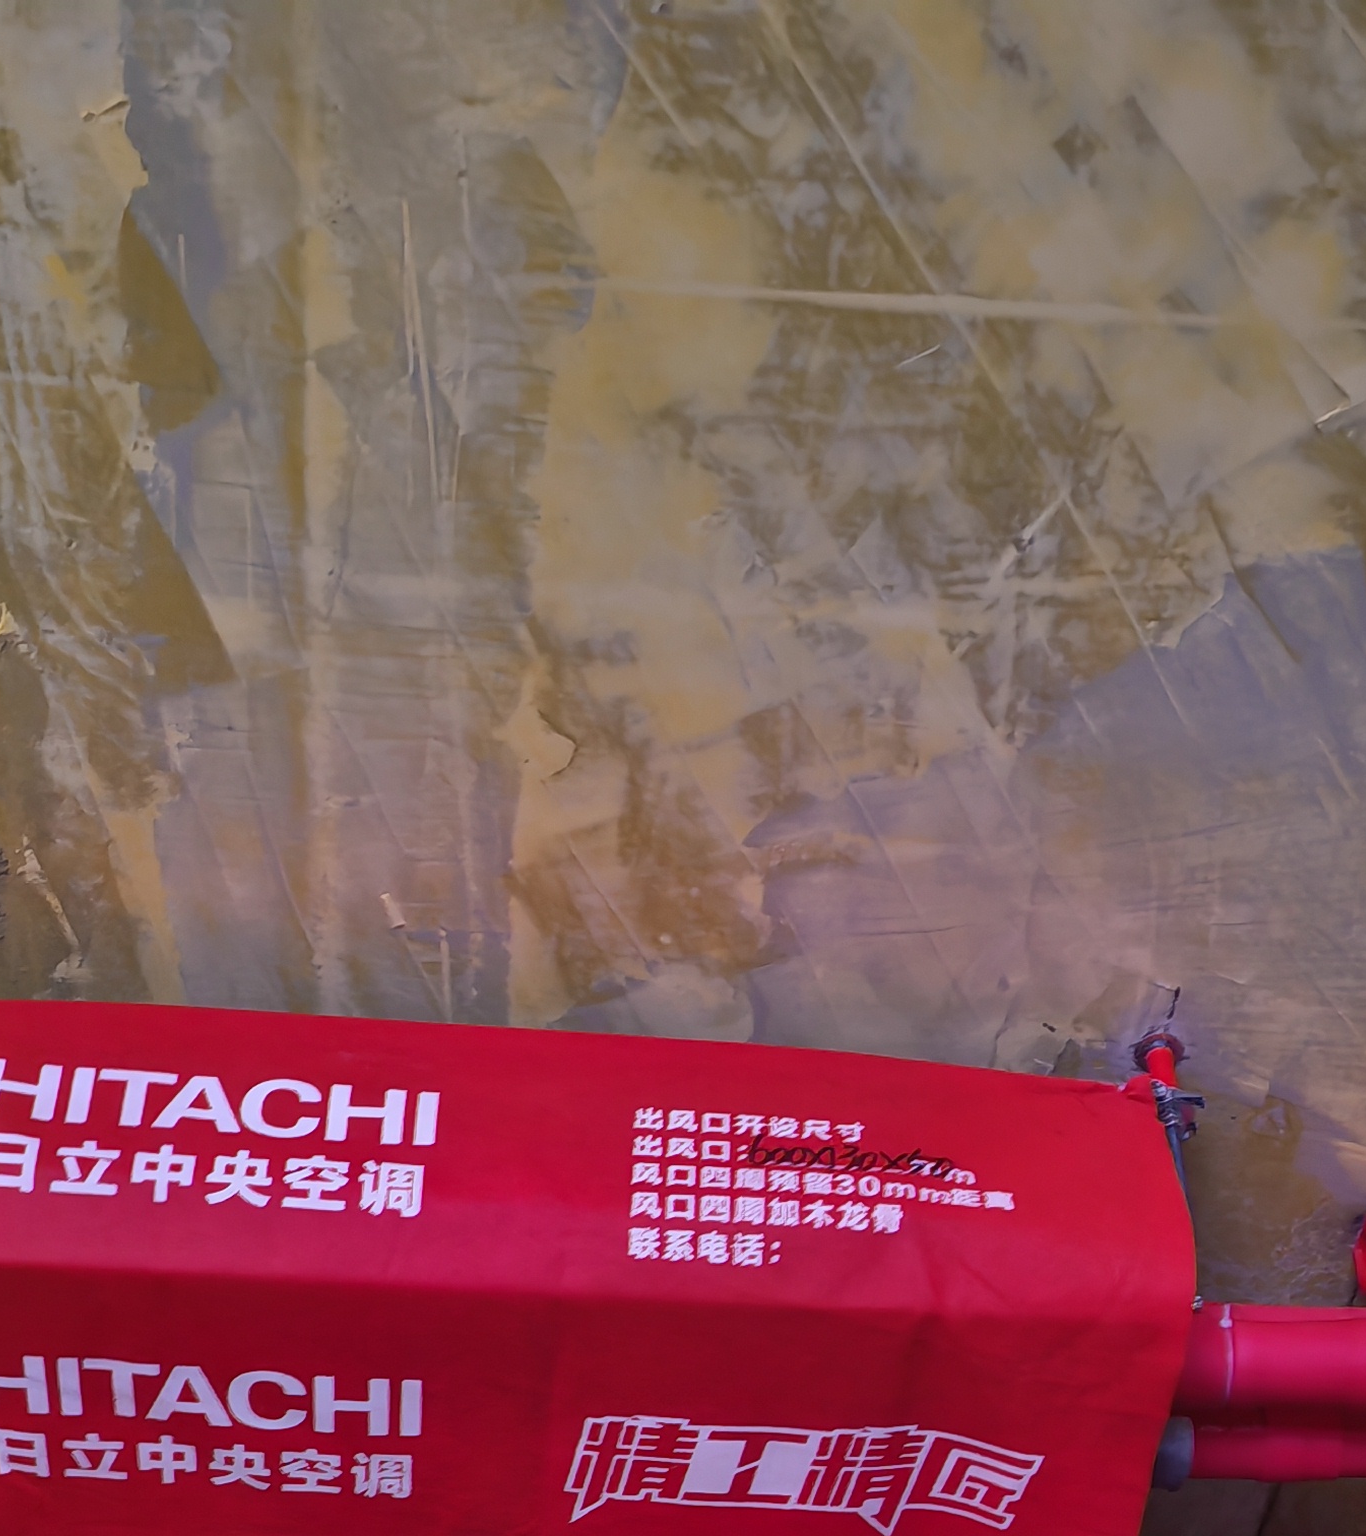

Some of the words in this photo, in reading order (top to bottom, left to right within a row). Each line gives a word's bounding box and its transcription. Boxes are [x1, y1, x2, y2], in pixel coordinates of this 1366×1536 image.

[632, 1106, 866, 1143] 出风口开设尺寸
[627, 1226, 783, 1268] 联系电话：
